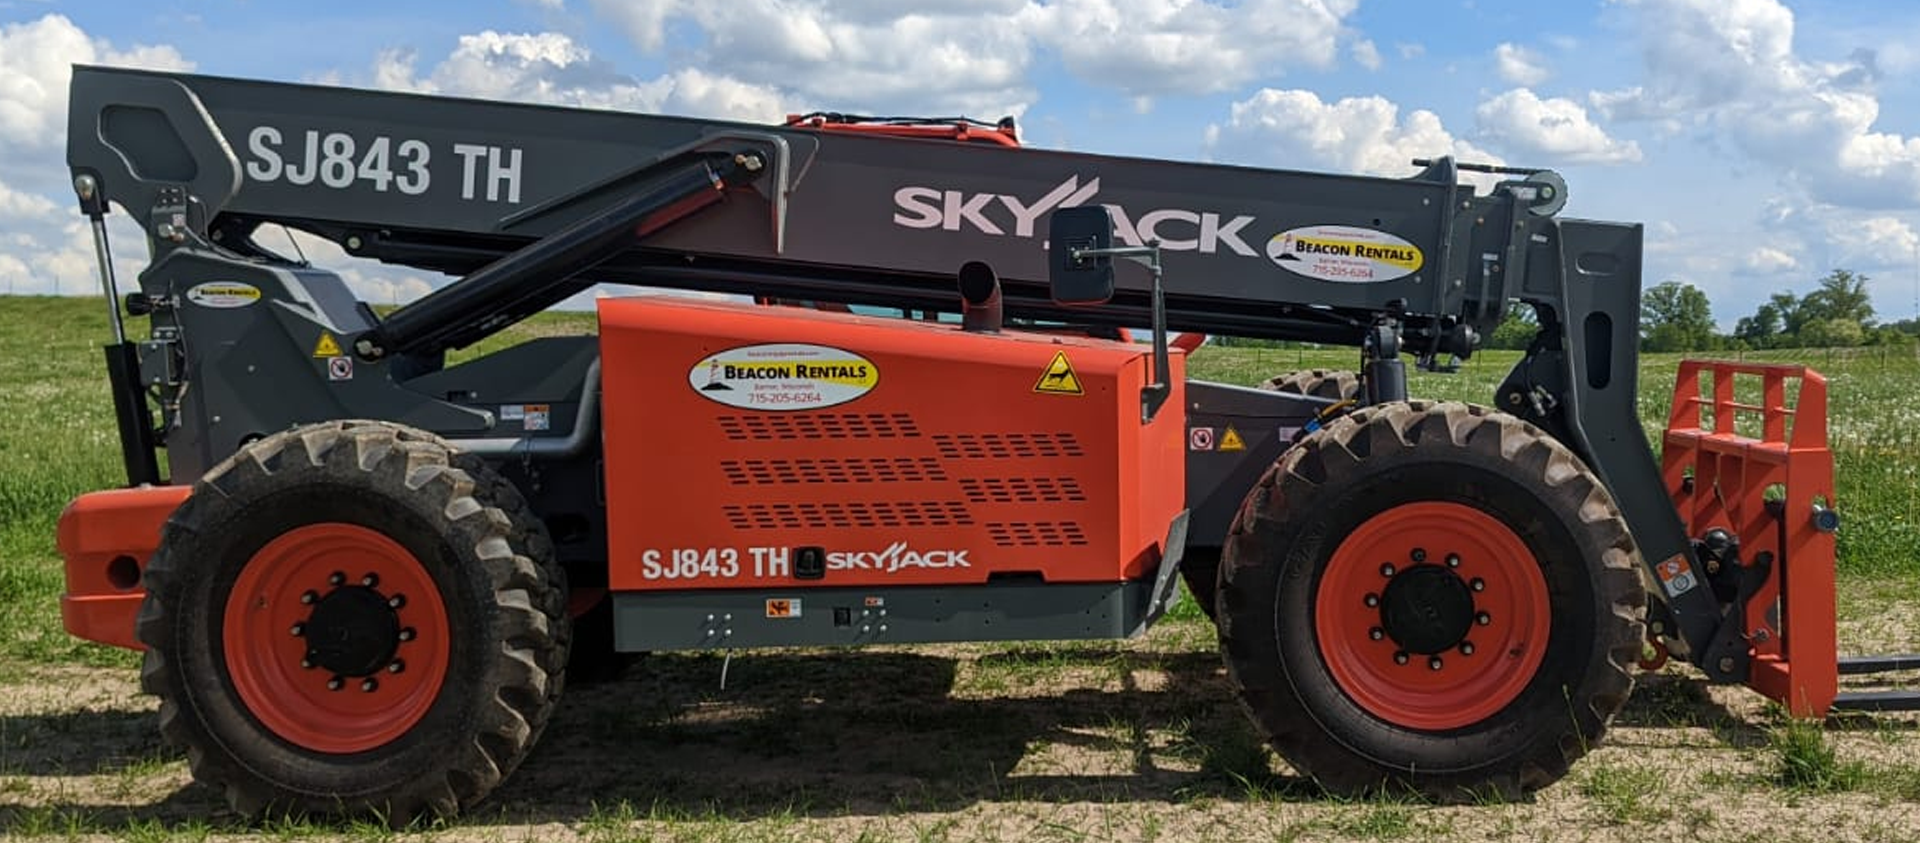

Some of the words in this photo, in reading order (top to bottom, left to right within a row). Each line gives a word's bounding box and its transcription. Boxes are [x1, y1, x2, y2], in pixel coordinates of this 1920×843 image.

[246, 126, 431, 195] SJ843
[453, 143, 523, 204] TH
[1295, 239, 1350, 256] BEACON
[1355, 244, 1415, 261] RENTALS
[724, 364, 790, 380] BEACON
[796, 364, 867, 379] RENTALS
[642, 549, 739, 580] SJ843
[749, 547, 789, 577] TH
[826, 541, 972, 573] SKYJACK
